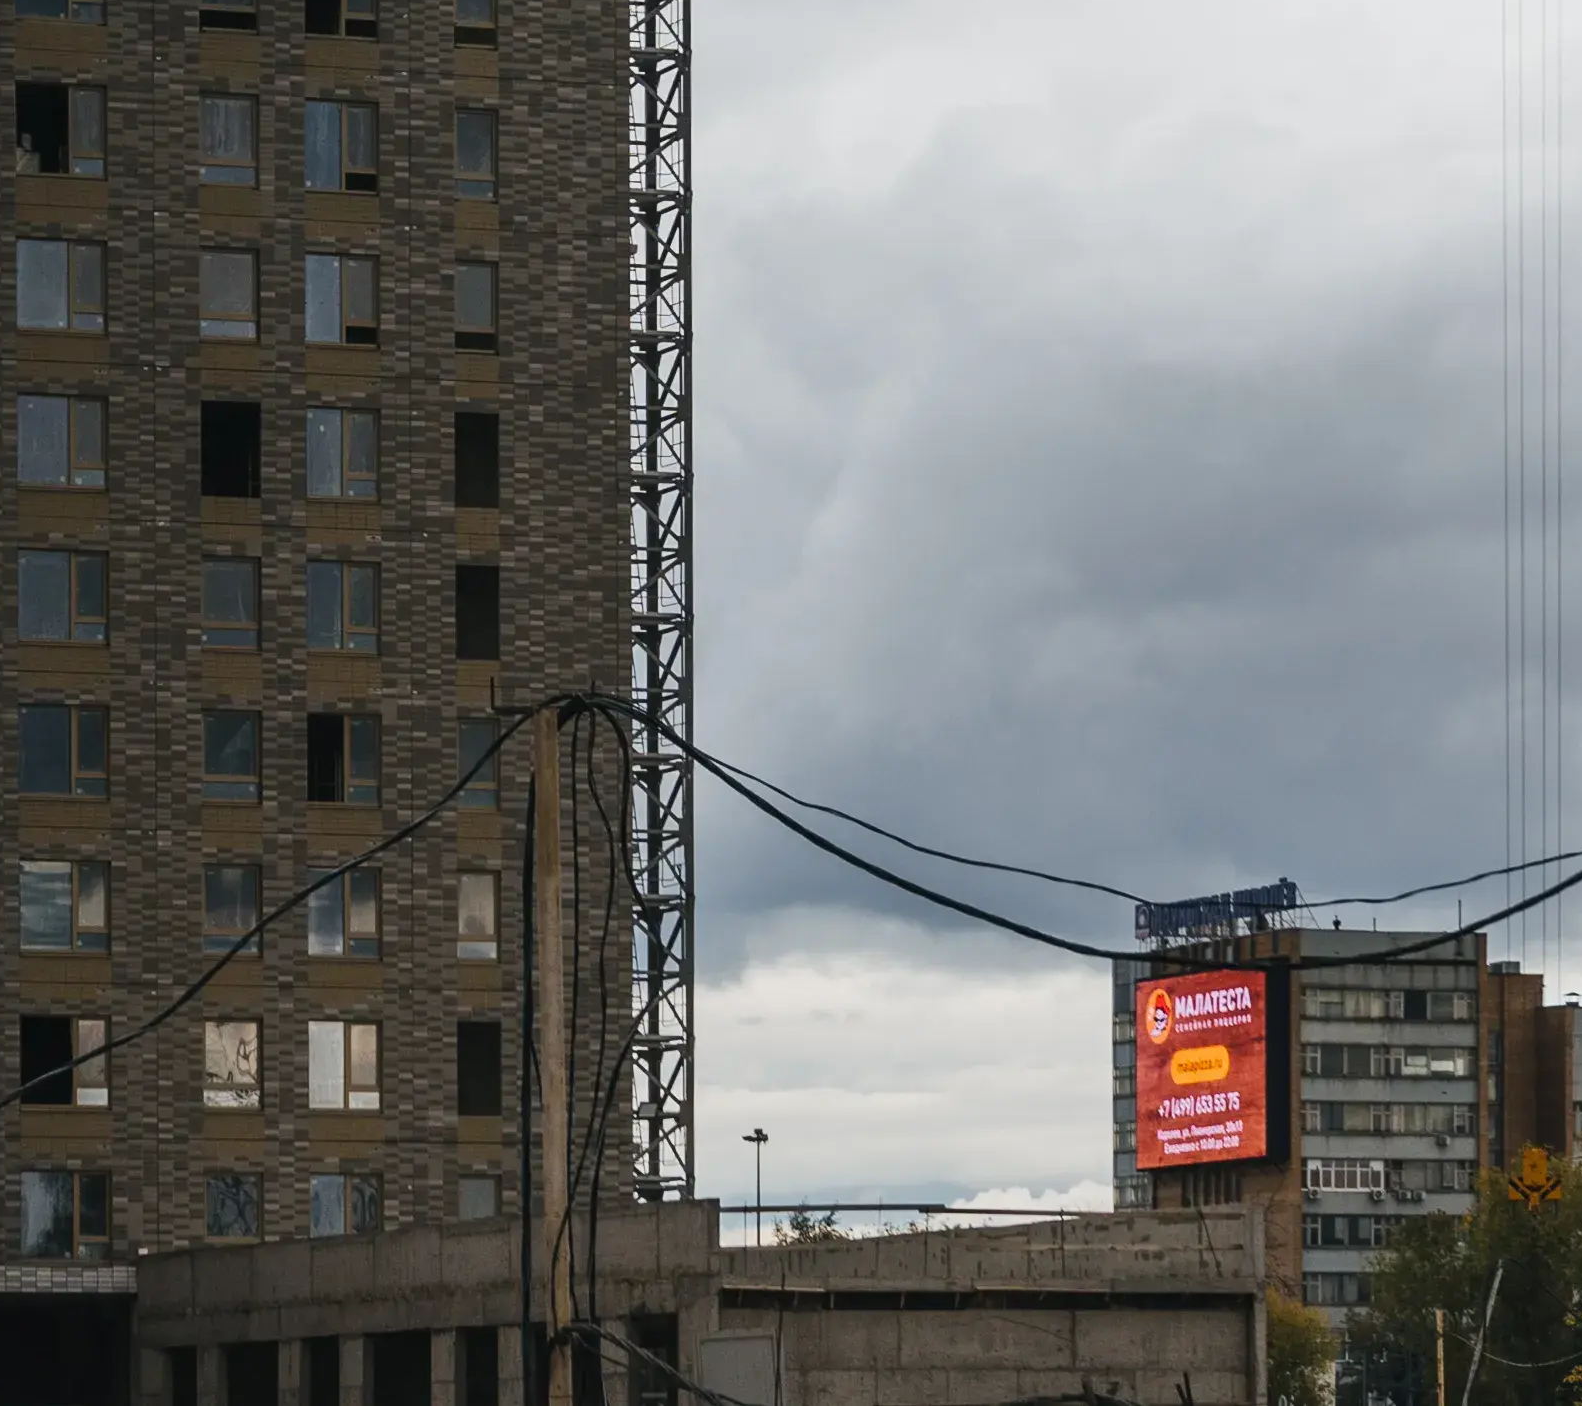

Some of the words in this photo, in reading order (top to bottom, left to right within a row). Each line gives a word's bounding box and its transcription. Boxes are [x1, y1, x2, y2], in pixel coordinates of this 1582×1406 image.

[1175, 986, 1251, 1018] МАЛАТЕСТА
[1158, 1100, 1170, 1118] +7
[1171, 1095, 1194, 1118] (499)
[1195, 1095, 1213, 1115] 653
[1213, 1092, 1227, 1113] 55
[1226, 1091, 1240, 1111] 75
